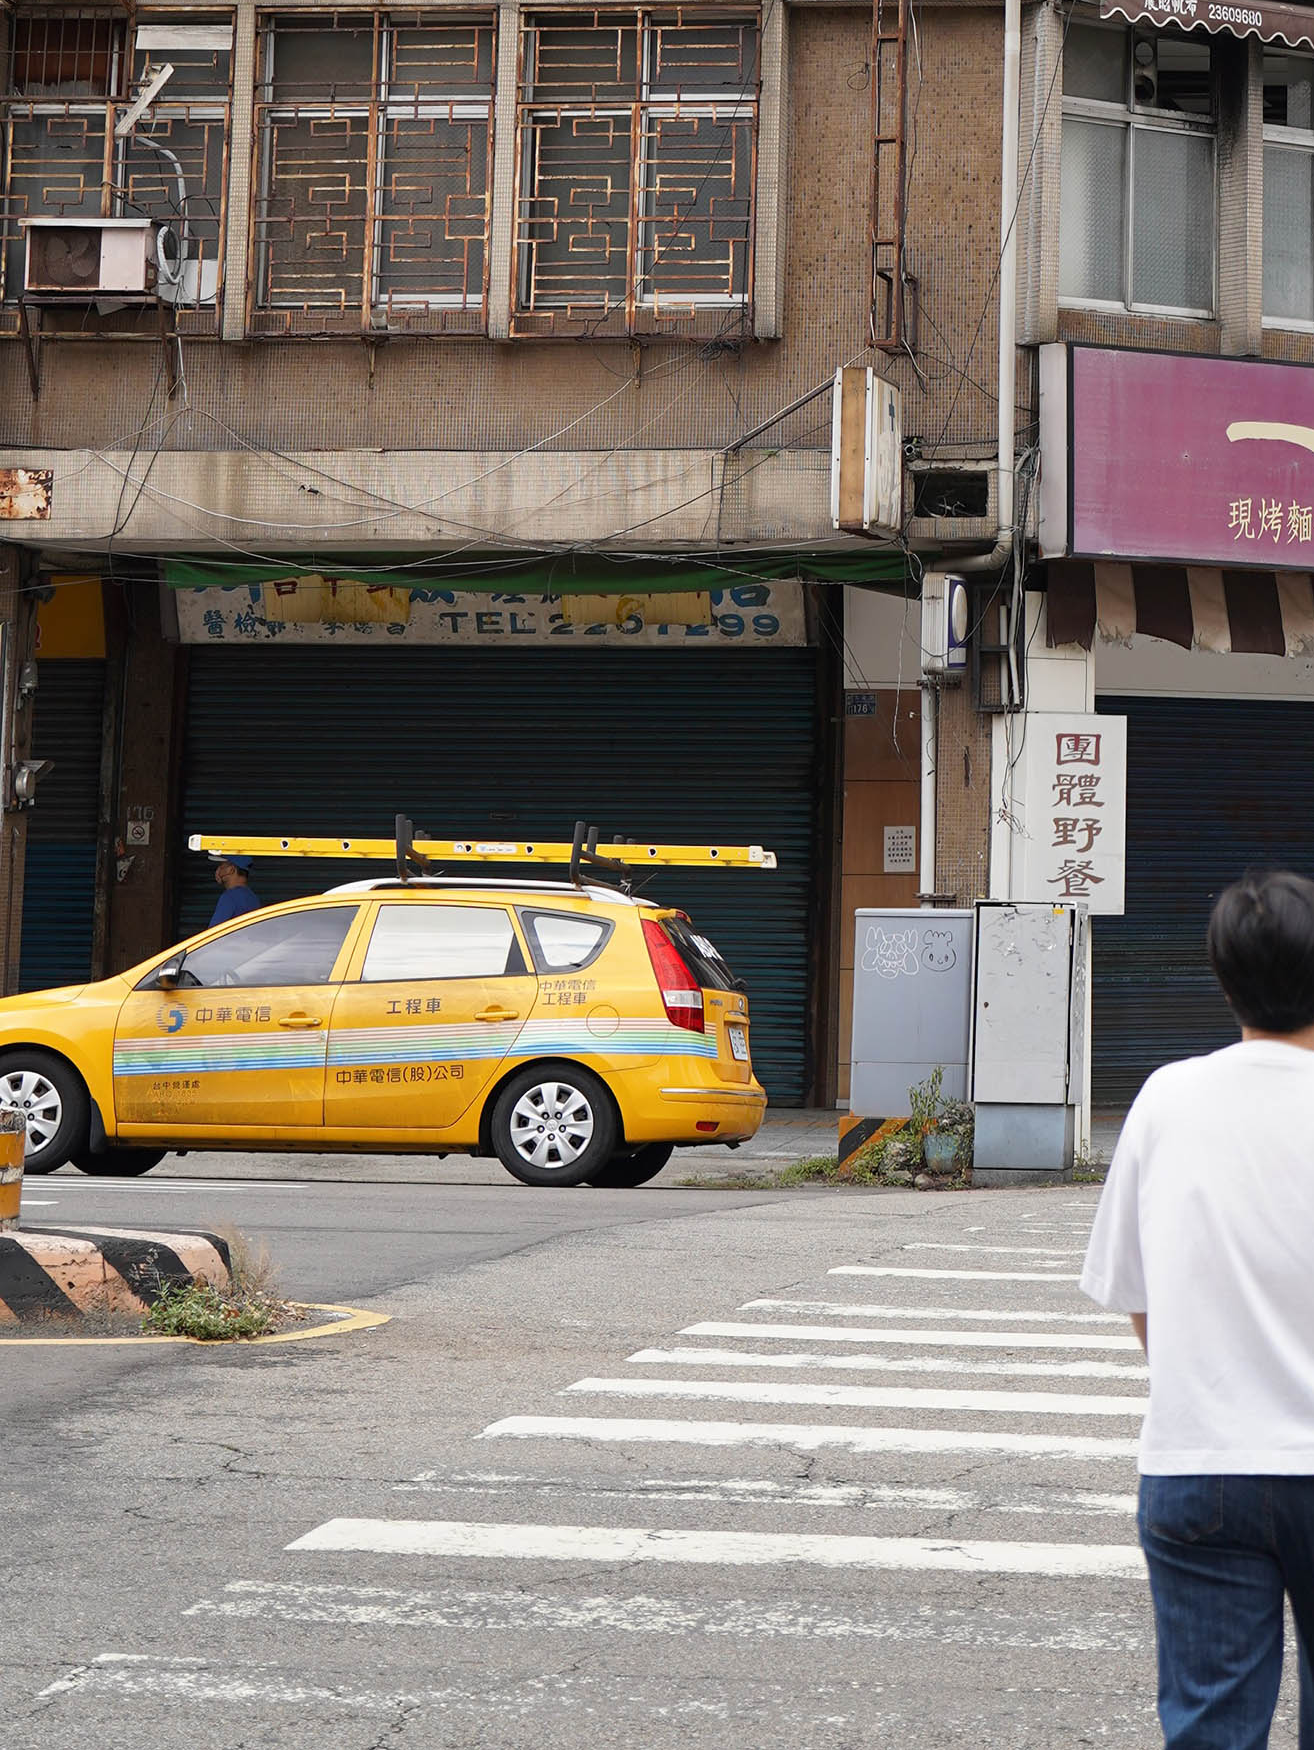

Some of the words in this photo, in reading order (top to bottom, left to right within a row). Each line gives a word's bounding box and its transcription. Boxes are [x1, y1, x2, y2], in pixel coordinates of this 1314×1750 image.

[1208, 3, 1262, 27] 23609680
[439, 612, 537, 635] TEL
[1047, 733, 1105, 897] 團體野餐
[539, 979, 598, 992] 中華電信
[386, 998, 442, 1015] 工程車
[542, 992, 588, 1006] 工程車
[195, 1006, 272, 1024] 中華電信
[336, 1064, 464, 1085] 中華電信(股)公司
